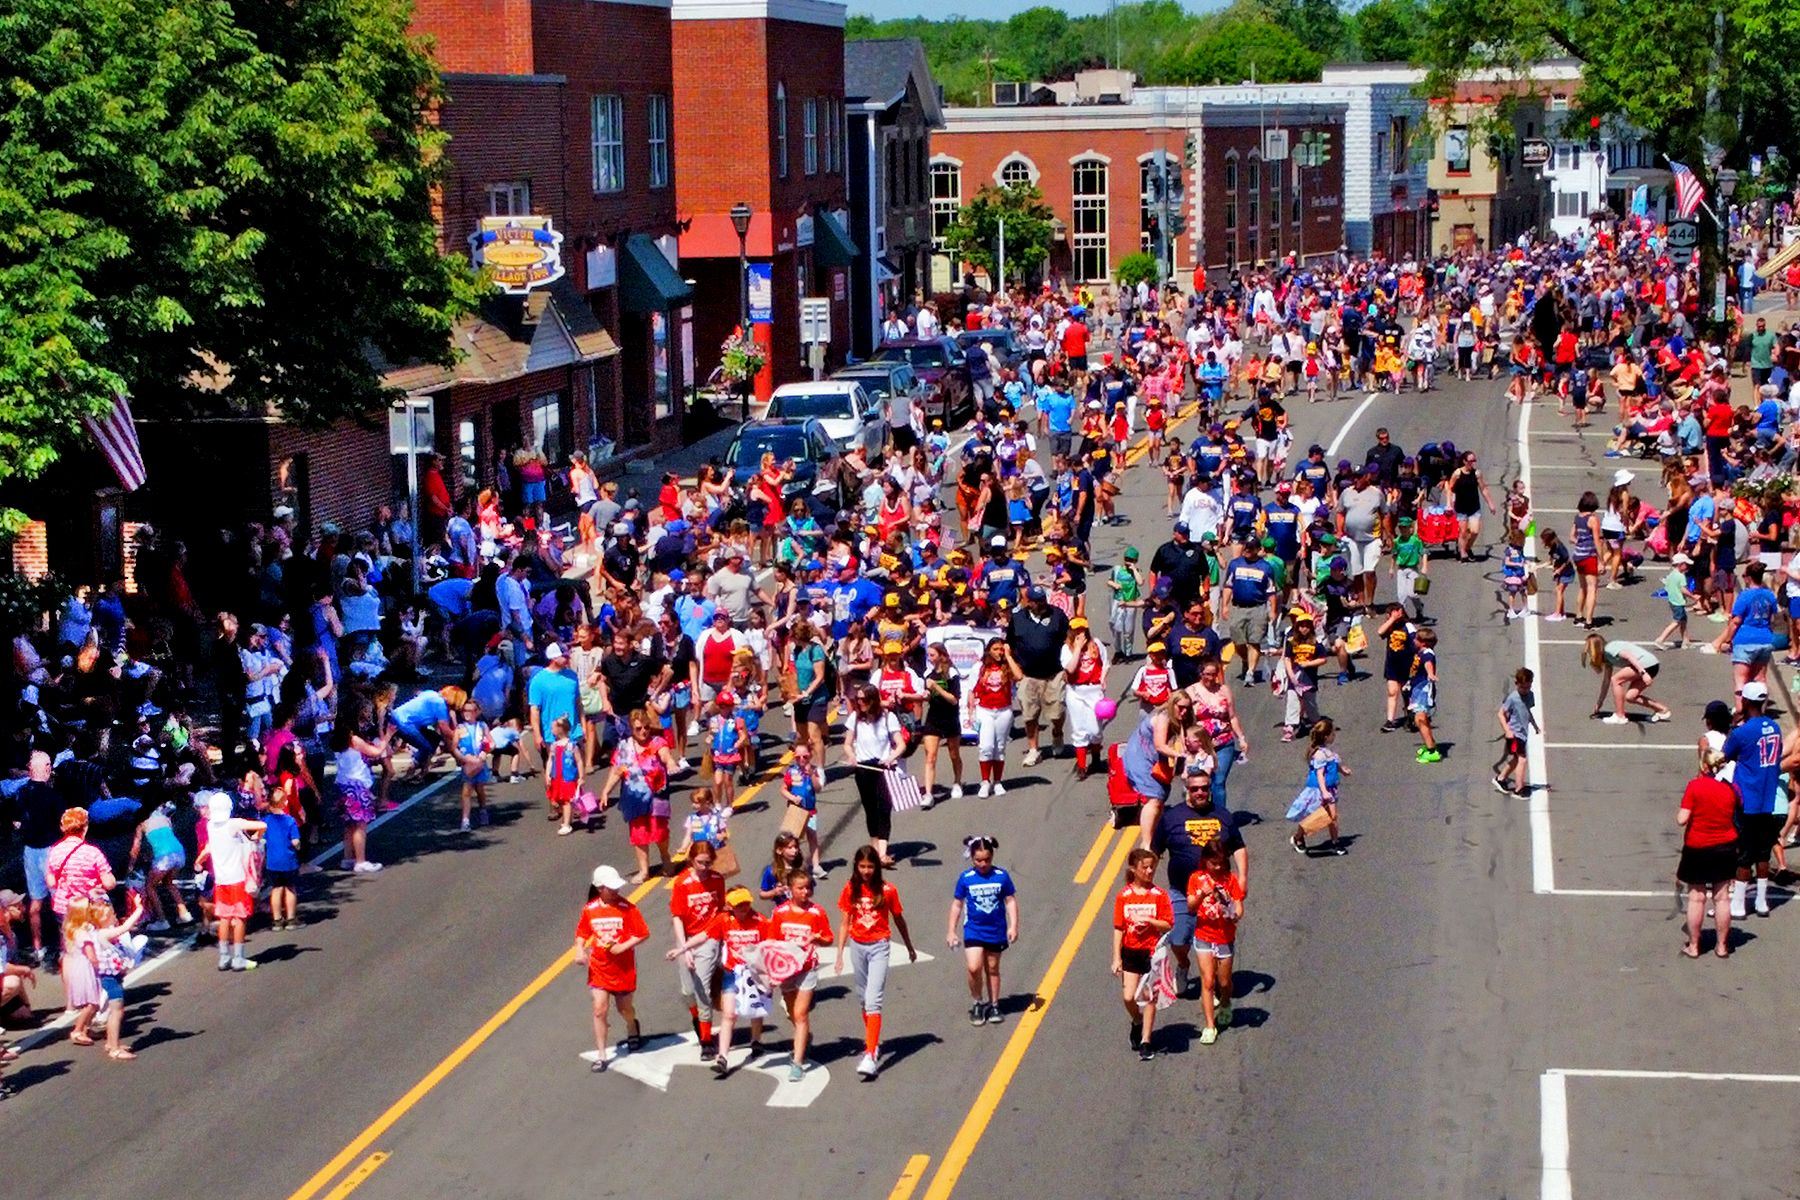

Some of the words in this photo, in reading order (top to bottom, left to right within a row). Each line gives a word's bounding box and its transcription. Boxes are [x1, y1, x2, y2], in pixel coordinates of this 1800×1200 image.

[494, 228, 535, 241] VICTOR
[1669, 228, 1695, 240] 444
[487, 268, 528, 282] ILLAGE
[529, 267, 550, 281] INN
[1756, 734, 1780, 768] 17
